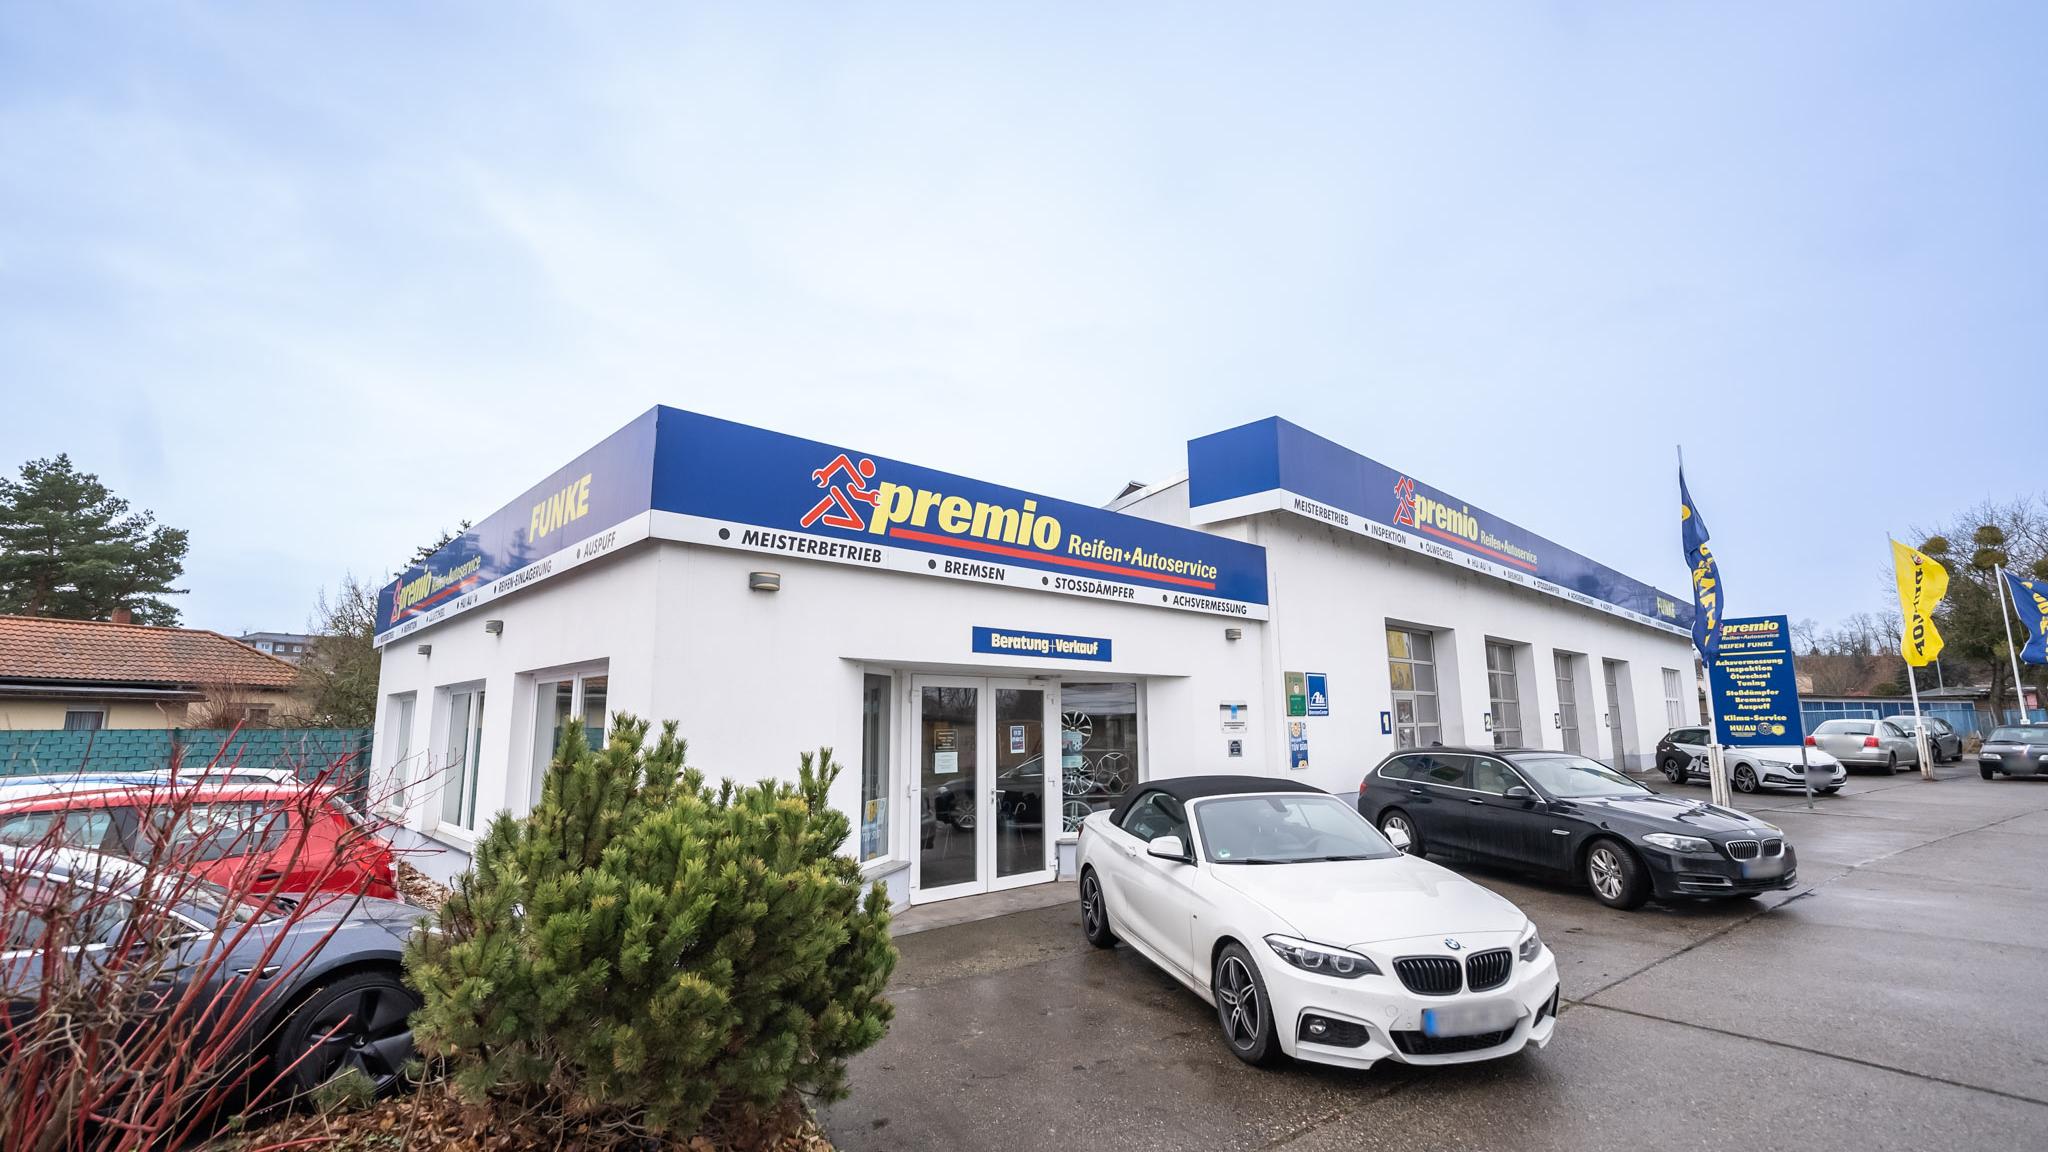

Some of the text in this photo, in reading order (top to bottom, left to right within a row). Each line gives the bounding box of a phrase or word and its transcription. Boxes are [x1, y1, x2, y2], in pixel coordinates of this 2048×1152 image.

[528, 473, 592, 543] FUNKE
[868, 481, 1061, 551] premio
[1294, 498, 1349, 526] MEISTERBETRIEB
[1371, 524, 1407, 545] INSPEKTION
[1414, 494, 1479, 542] premio
[584, 531, 616, 558] AUSPUFF
[1068, 533, 1217, 579] Reifen+Autoservice
[399, 563, 432, 611] premio
[741, 529, 1247, 615] MEISTERBETRIEB BREMSEN STOSSDÄMPFER ACHSVERMESSUNG
[991, 633, 1098, 655] Beratung+Verkauf
[1722, 620, 1779, 636] premio
[1715, 658, 1783, 666] Achsvermessung
[1726, 665, 1773, 673] Inspektion
[1485, 715, 1491, 730] 2
[1738, 703, 1771, 711] Auspuff
